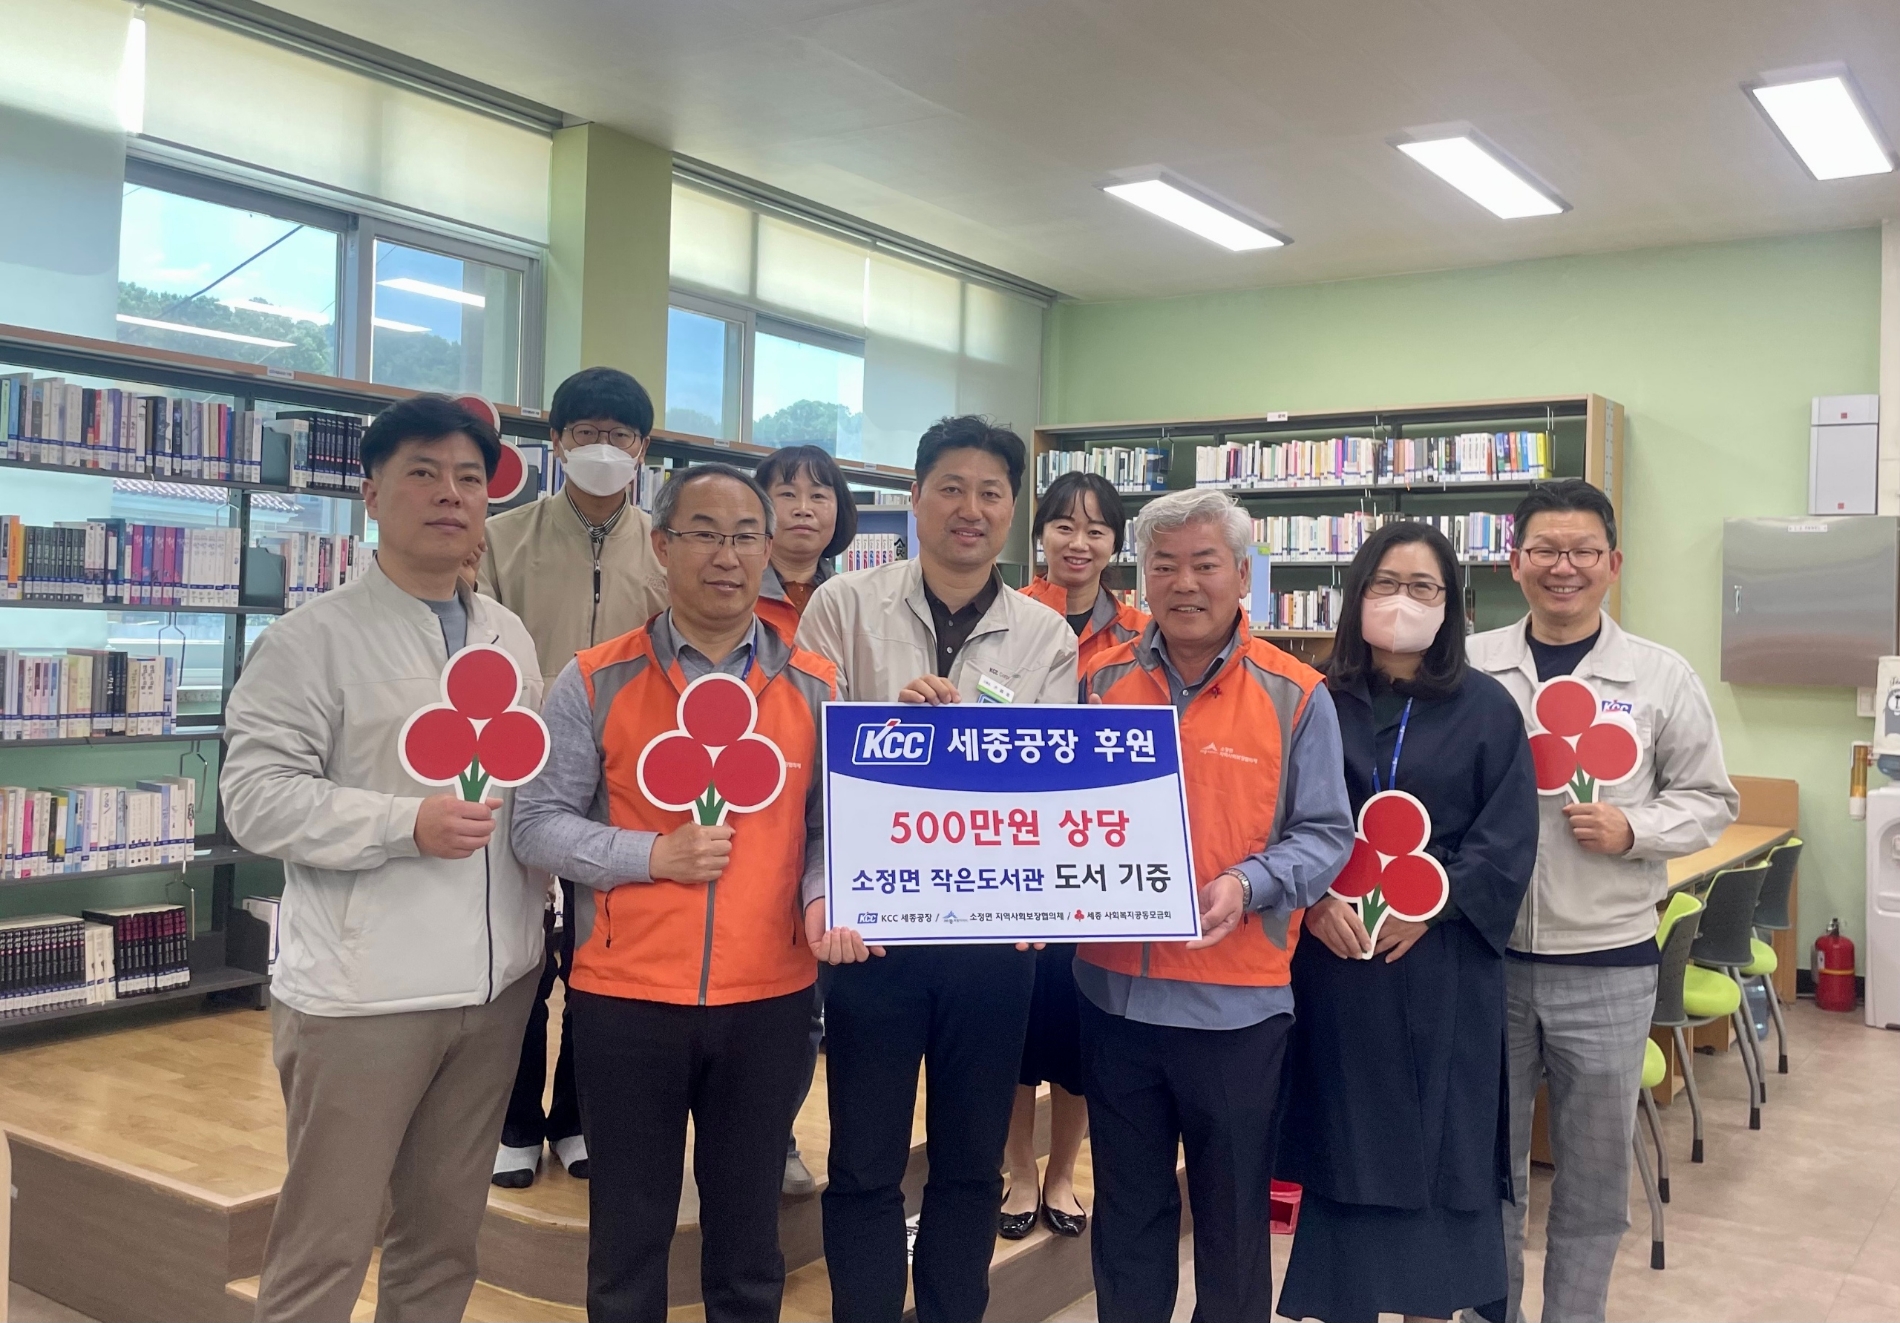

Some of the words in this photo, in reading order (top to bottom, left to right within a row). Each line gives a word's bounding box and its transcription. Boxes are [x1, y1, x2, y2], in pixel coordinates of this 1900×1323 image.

[862, 719, 924, 759] KCC
[947, 728, 1079, 764] 세종공장
[1094, 728, 1157, 763] 후원
[890, 809, 1041, 846] 500만원
[1058, 808, 1130, 847] 상당
[851, 868, 921, 895] 소정면
[931, 867, 1045, 893] 작은도서관
[1054, 863, 1107, 891] 도서
[1119, 862, 1172, 893] 기증
[859, 911, 877, 923] KCC
[881, 914, 899, 923] KCC
[900, 912, 933, 923] 세종공장
[969, 911, 993, 922] 소정면
[1087, 911, 1102, 921] 세종
